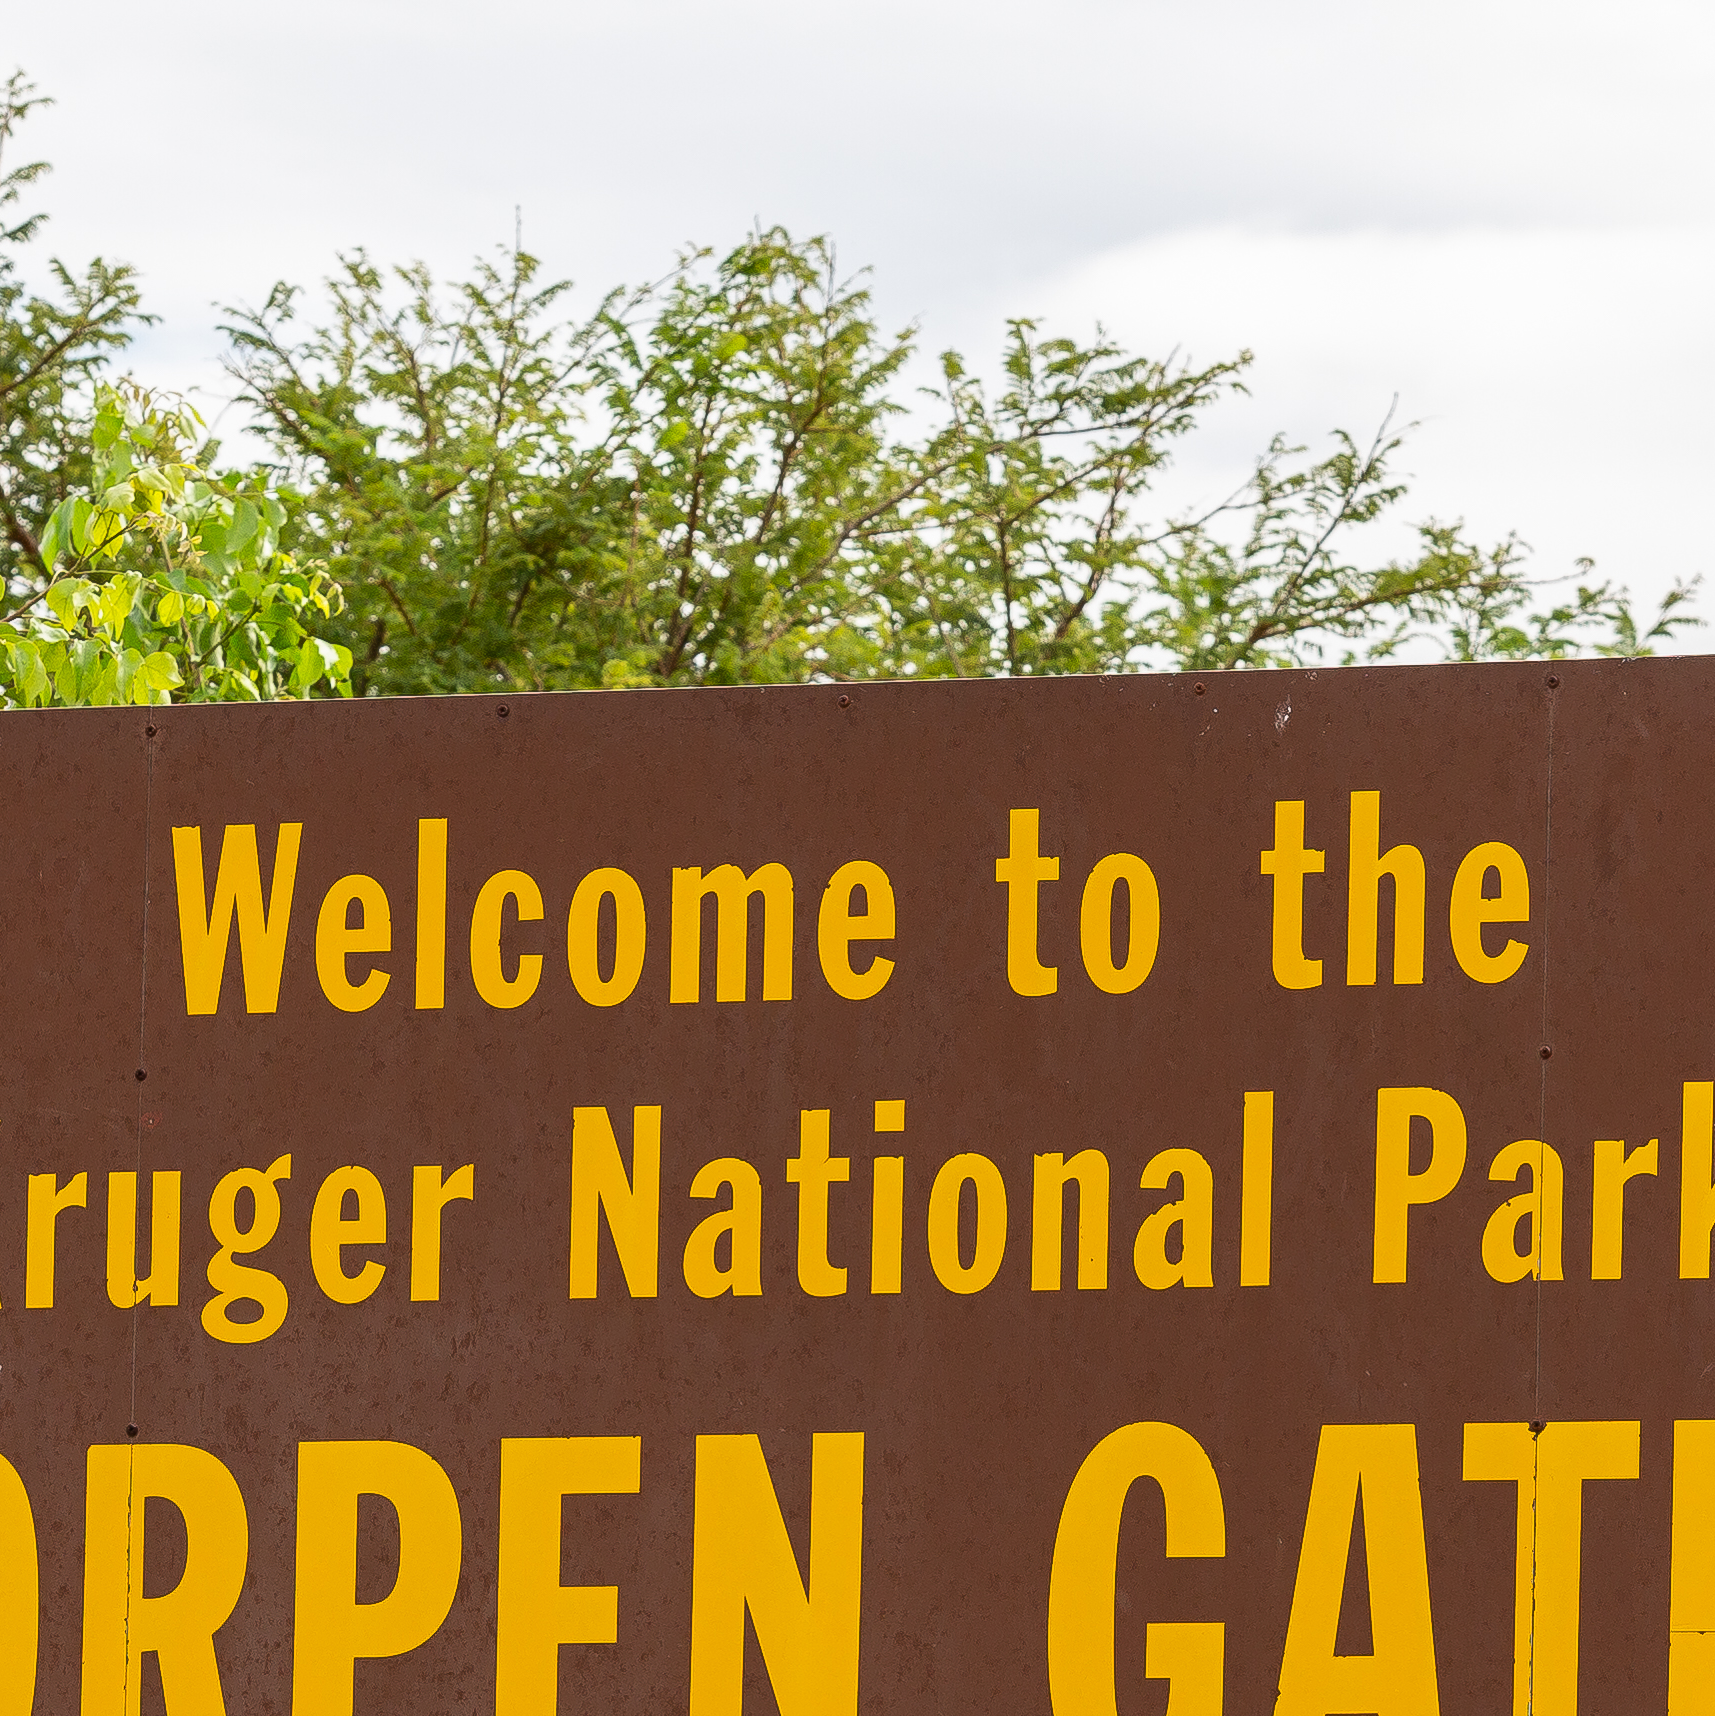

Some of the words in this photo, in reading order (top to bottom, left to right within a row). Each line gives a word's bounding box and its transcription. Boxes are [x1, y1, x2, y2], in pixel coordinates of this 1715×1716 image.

[171, 817, 896, 1016] Welcome
[995, 807, 1161, 997] to
[1259, 790, 1530, 990] the
[568, 1090, 1275, 1300] National
